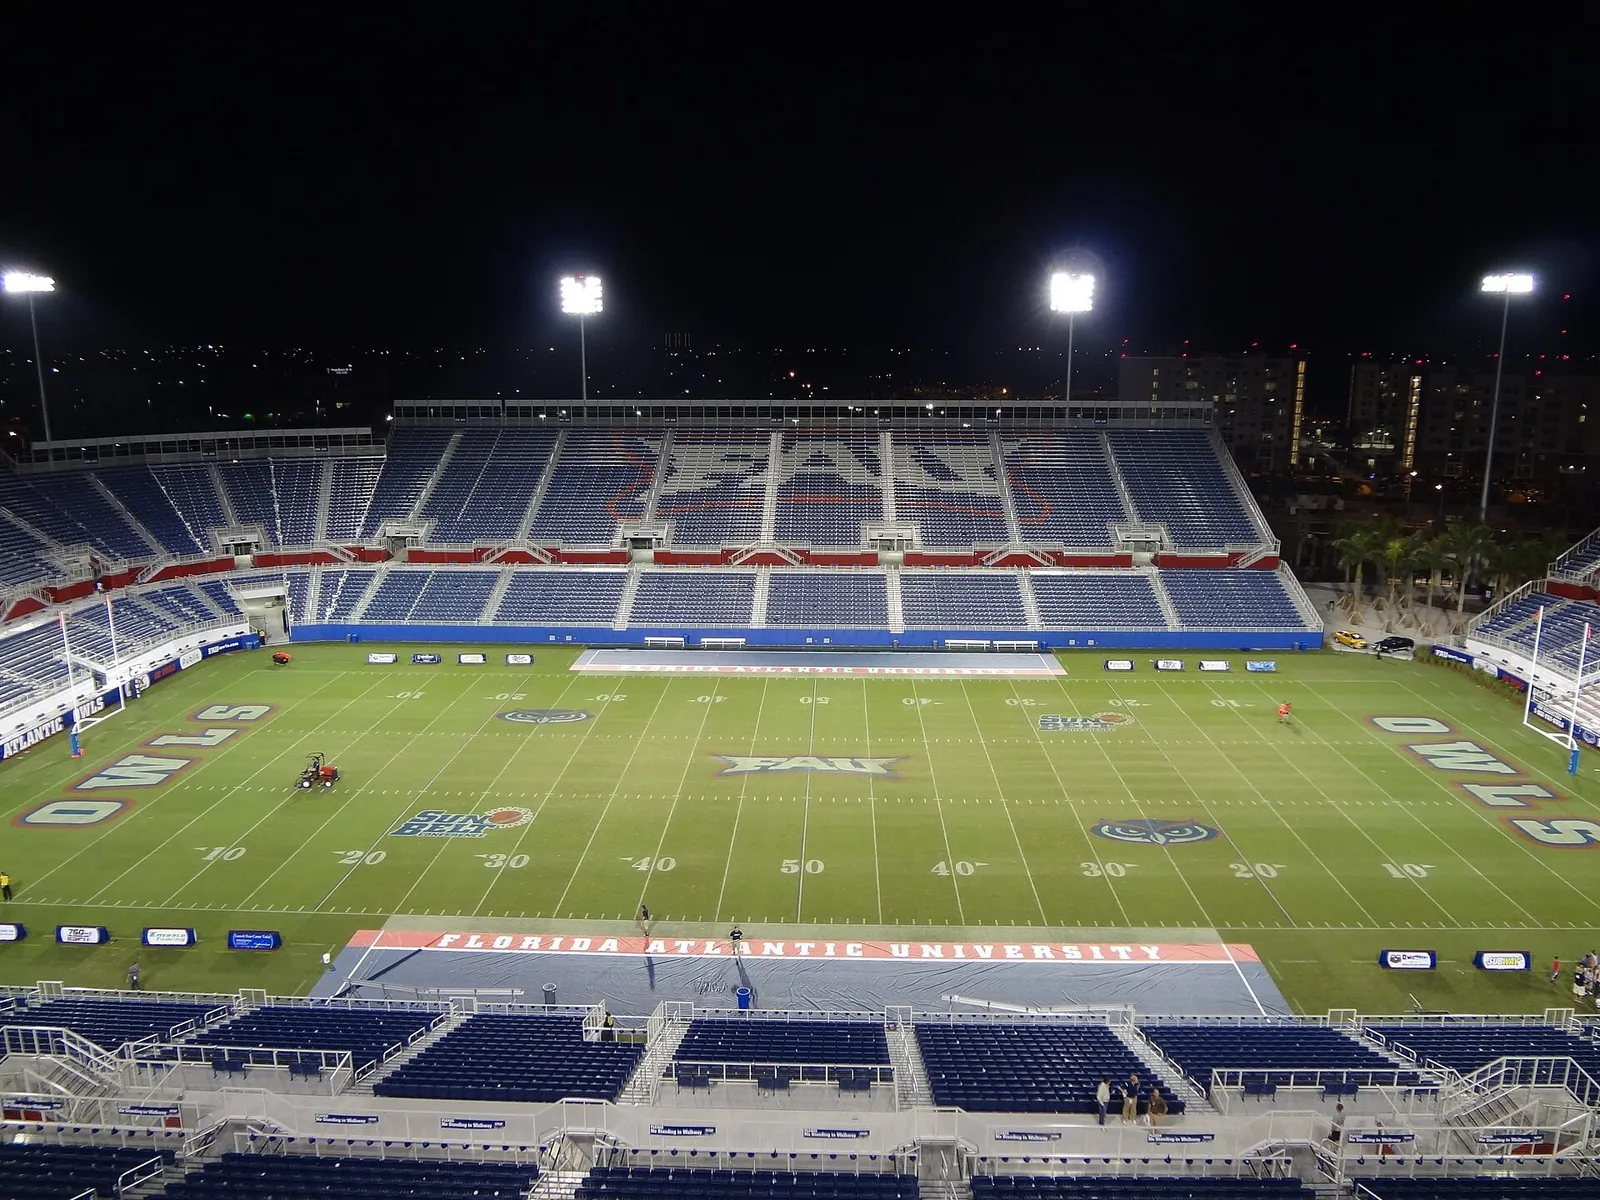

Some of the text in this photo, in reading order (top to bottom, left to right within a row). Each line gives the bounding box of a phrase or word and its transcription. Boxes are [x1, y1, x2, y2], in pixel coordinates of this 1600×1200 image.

[3, 717, 63, 759] ATLANTIC
[73, 696, 104, 722] OWLS
[22, 703, 273, 826] OWLS
[714, 754, 904, 776] FAU
[1371, 716, 1600, 845] OWLS
[409, 809, 493, 825] SUN
[388, 822, 498, 836] BELT
[202, 847, 246, 861] 10
[338, 851, 387, 865] 20
[484, 854, 530, 868] 30
[632, 857, 676, 871] 40
[781, 859, 825, 874] 50
[931, 861, 975, 876] 40
[1080, 862, 1126, 877] 30
[1229, 863, 1278, 878] 20
[1381, 863, 1429, 878] 10
[436, 933, 1161, 960] FLORIDA ATLANTIC UNIVERSITY
[1485, 956, 1522, 966] SUBWAY
